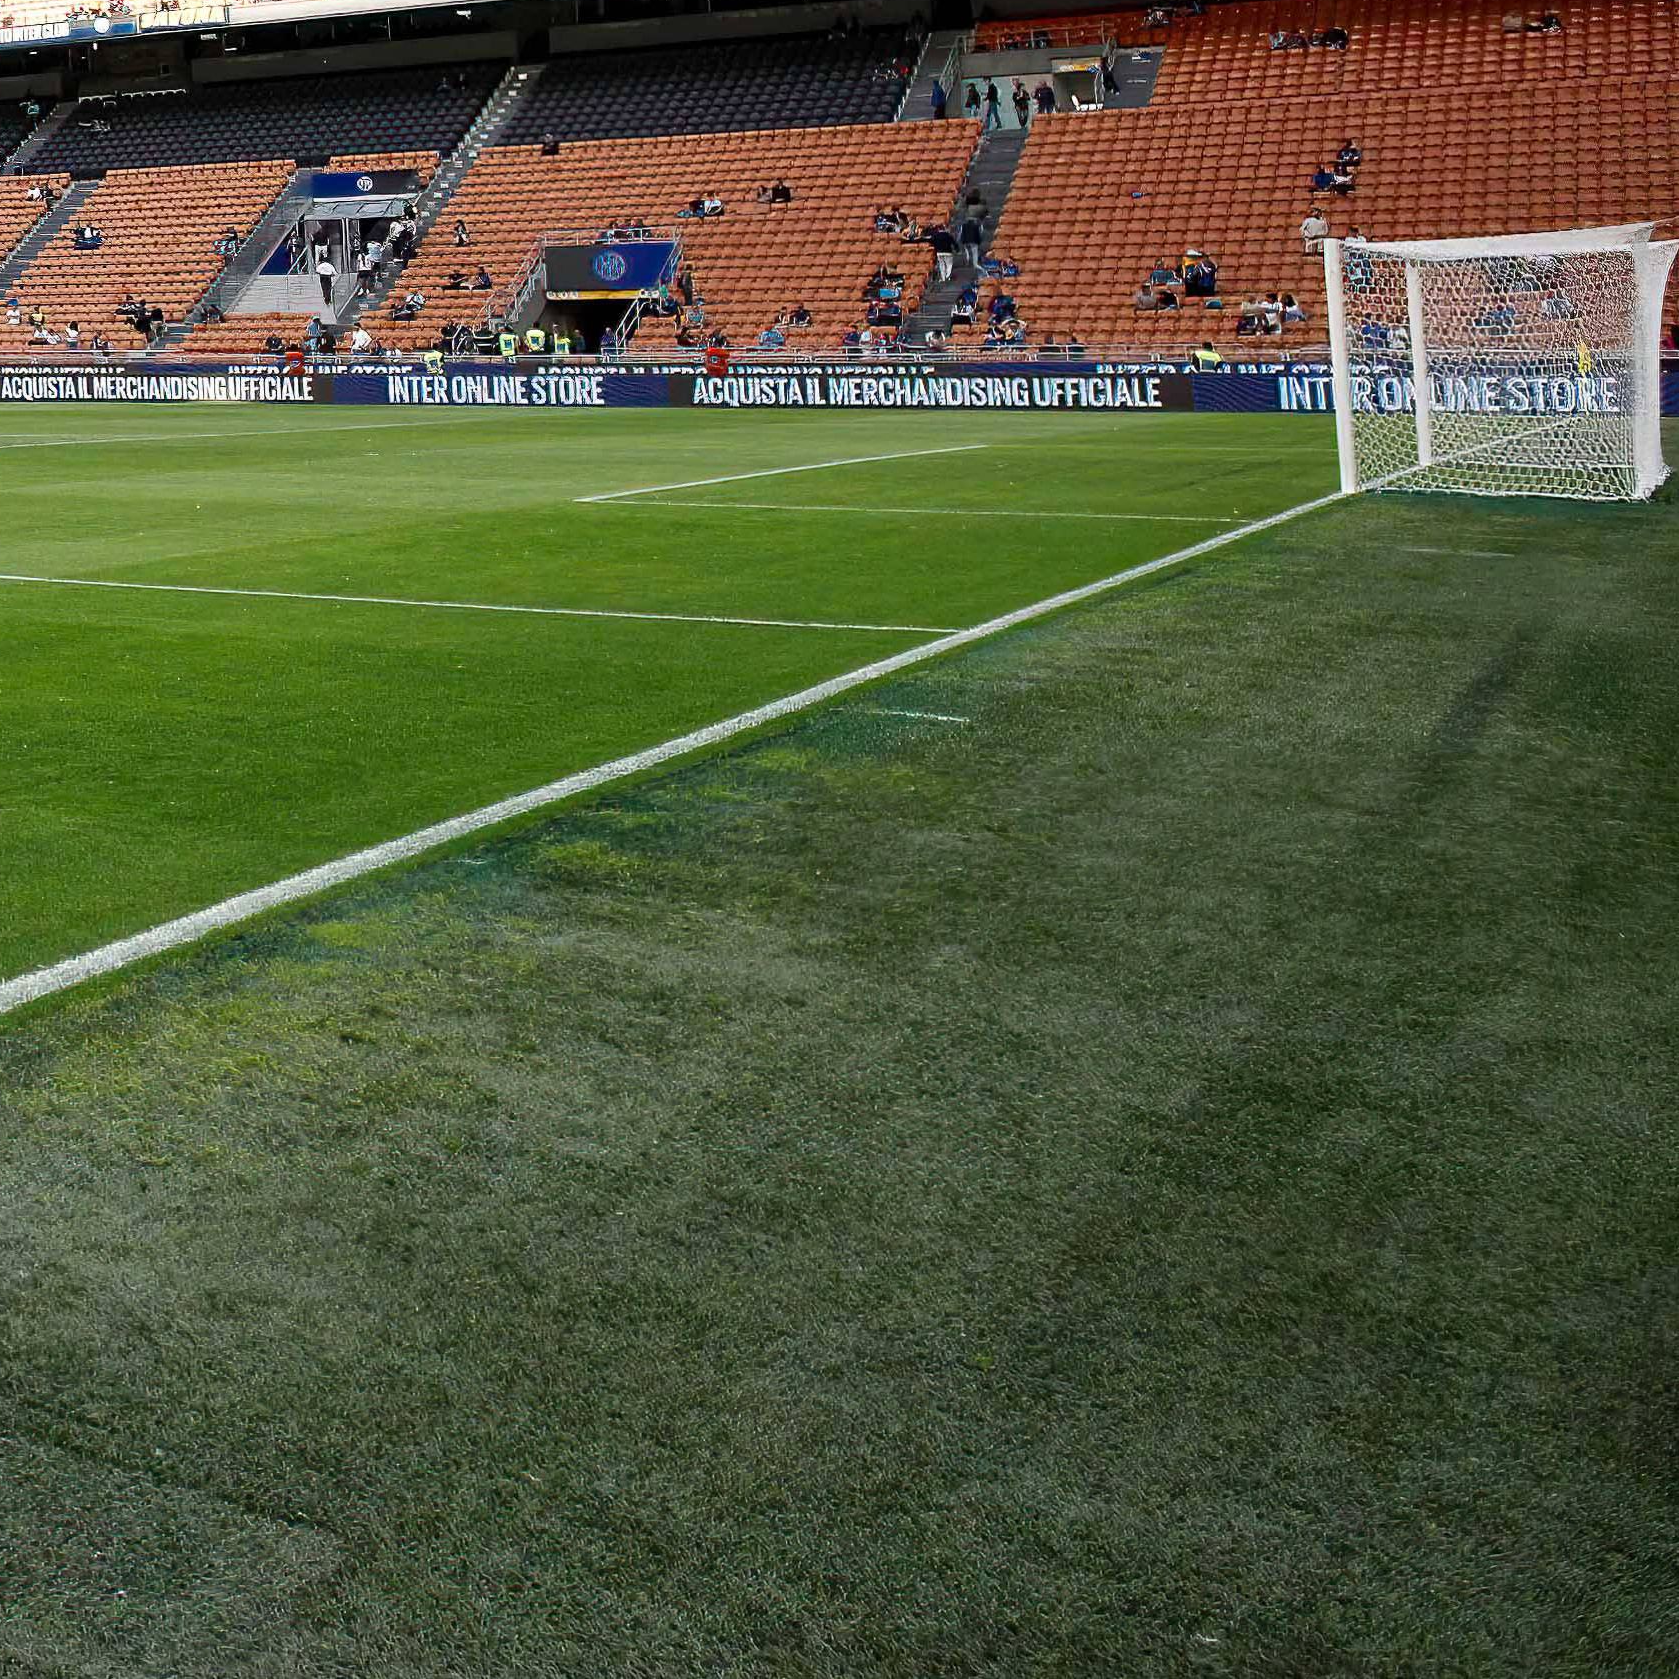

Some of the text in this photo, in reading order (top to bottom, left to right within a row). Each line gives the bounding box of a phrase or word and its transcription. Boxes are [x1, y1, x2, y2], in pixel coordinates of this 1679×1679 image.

[1, 376, 313, 401] ACQUISTA IL MERCHANDISING UFFICIALE
[388, 376, 605, 405] INTER ONLINE STORE
[693, 377, 1162, 408] ACQUISTA IL MERCHANDISING UFFICIALE
[1278, 376, 1372, 411] INTR
